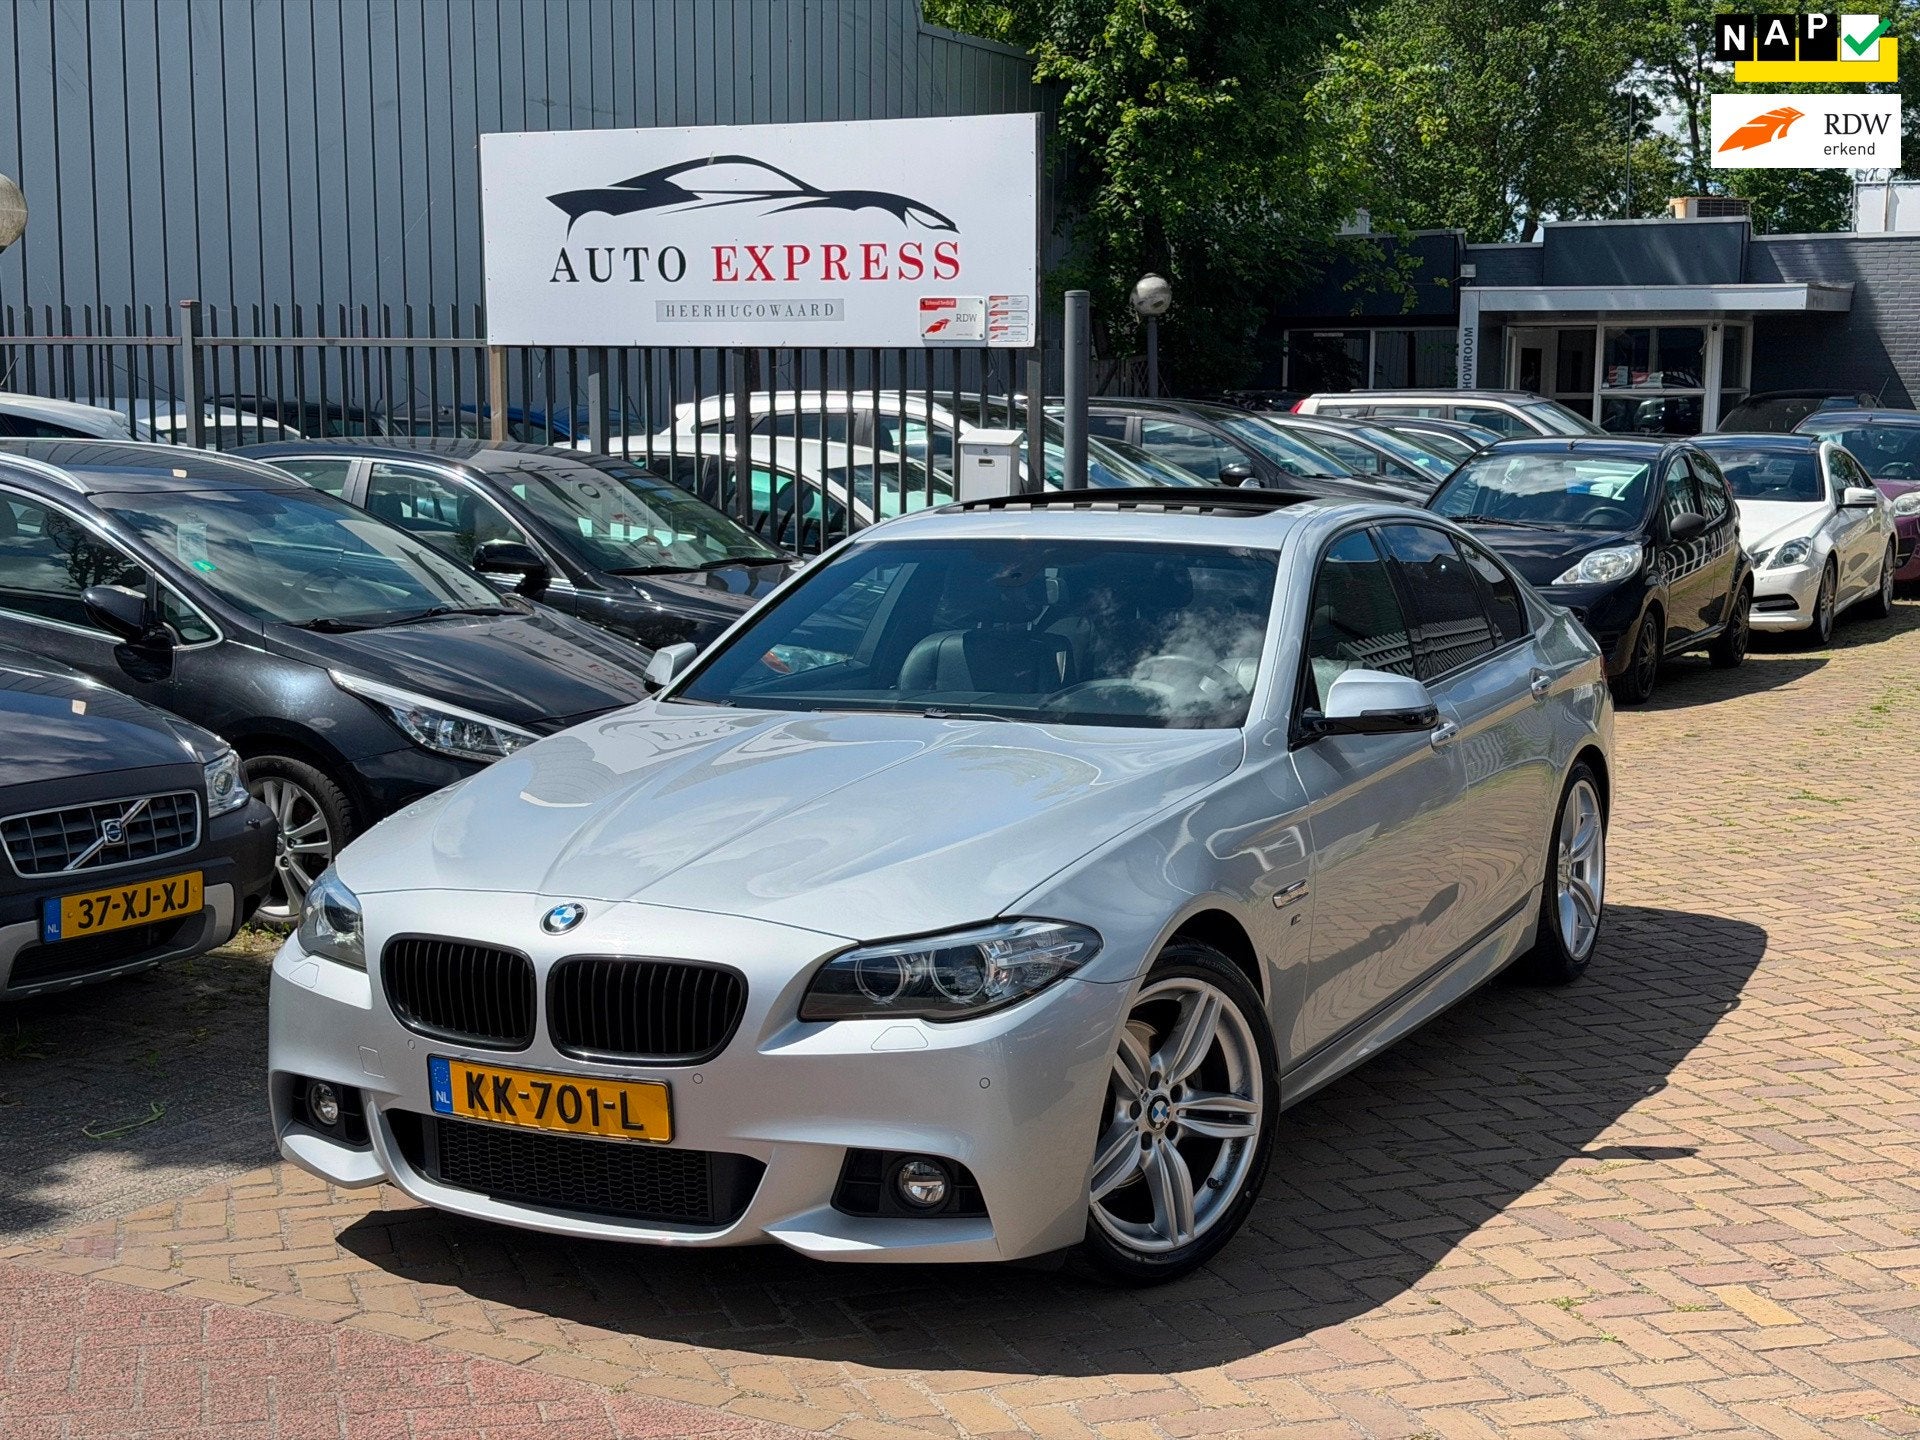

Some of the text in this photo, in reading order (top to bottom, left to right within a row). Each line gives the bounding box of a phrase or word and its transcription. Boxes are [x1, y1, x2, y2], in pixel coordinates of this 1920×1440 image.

[549, 241, 960, 283] AUTO EXPRESS
[665, 303, 835, 318] HEERHUGOWAARD
[955, 313, 978, 323] RDW
[1462, 327, 1474, 389] HOWROOM
[77, 879, 190, 930] 37-XJ-XJ
[47, 923, 60, 934] NL
[435, 1089, 450, 1104] NL
[465, 1070, 644, 1131] KK-701-L
